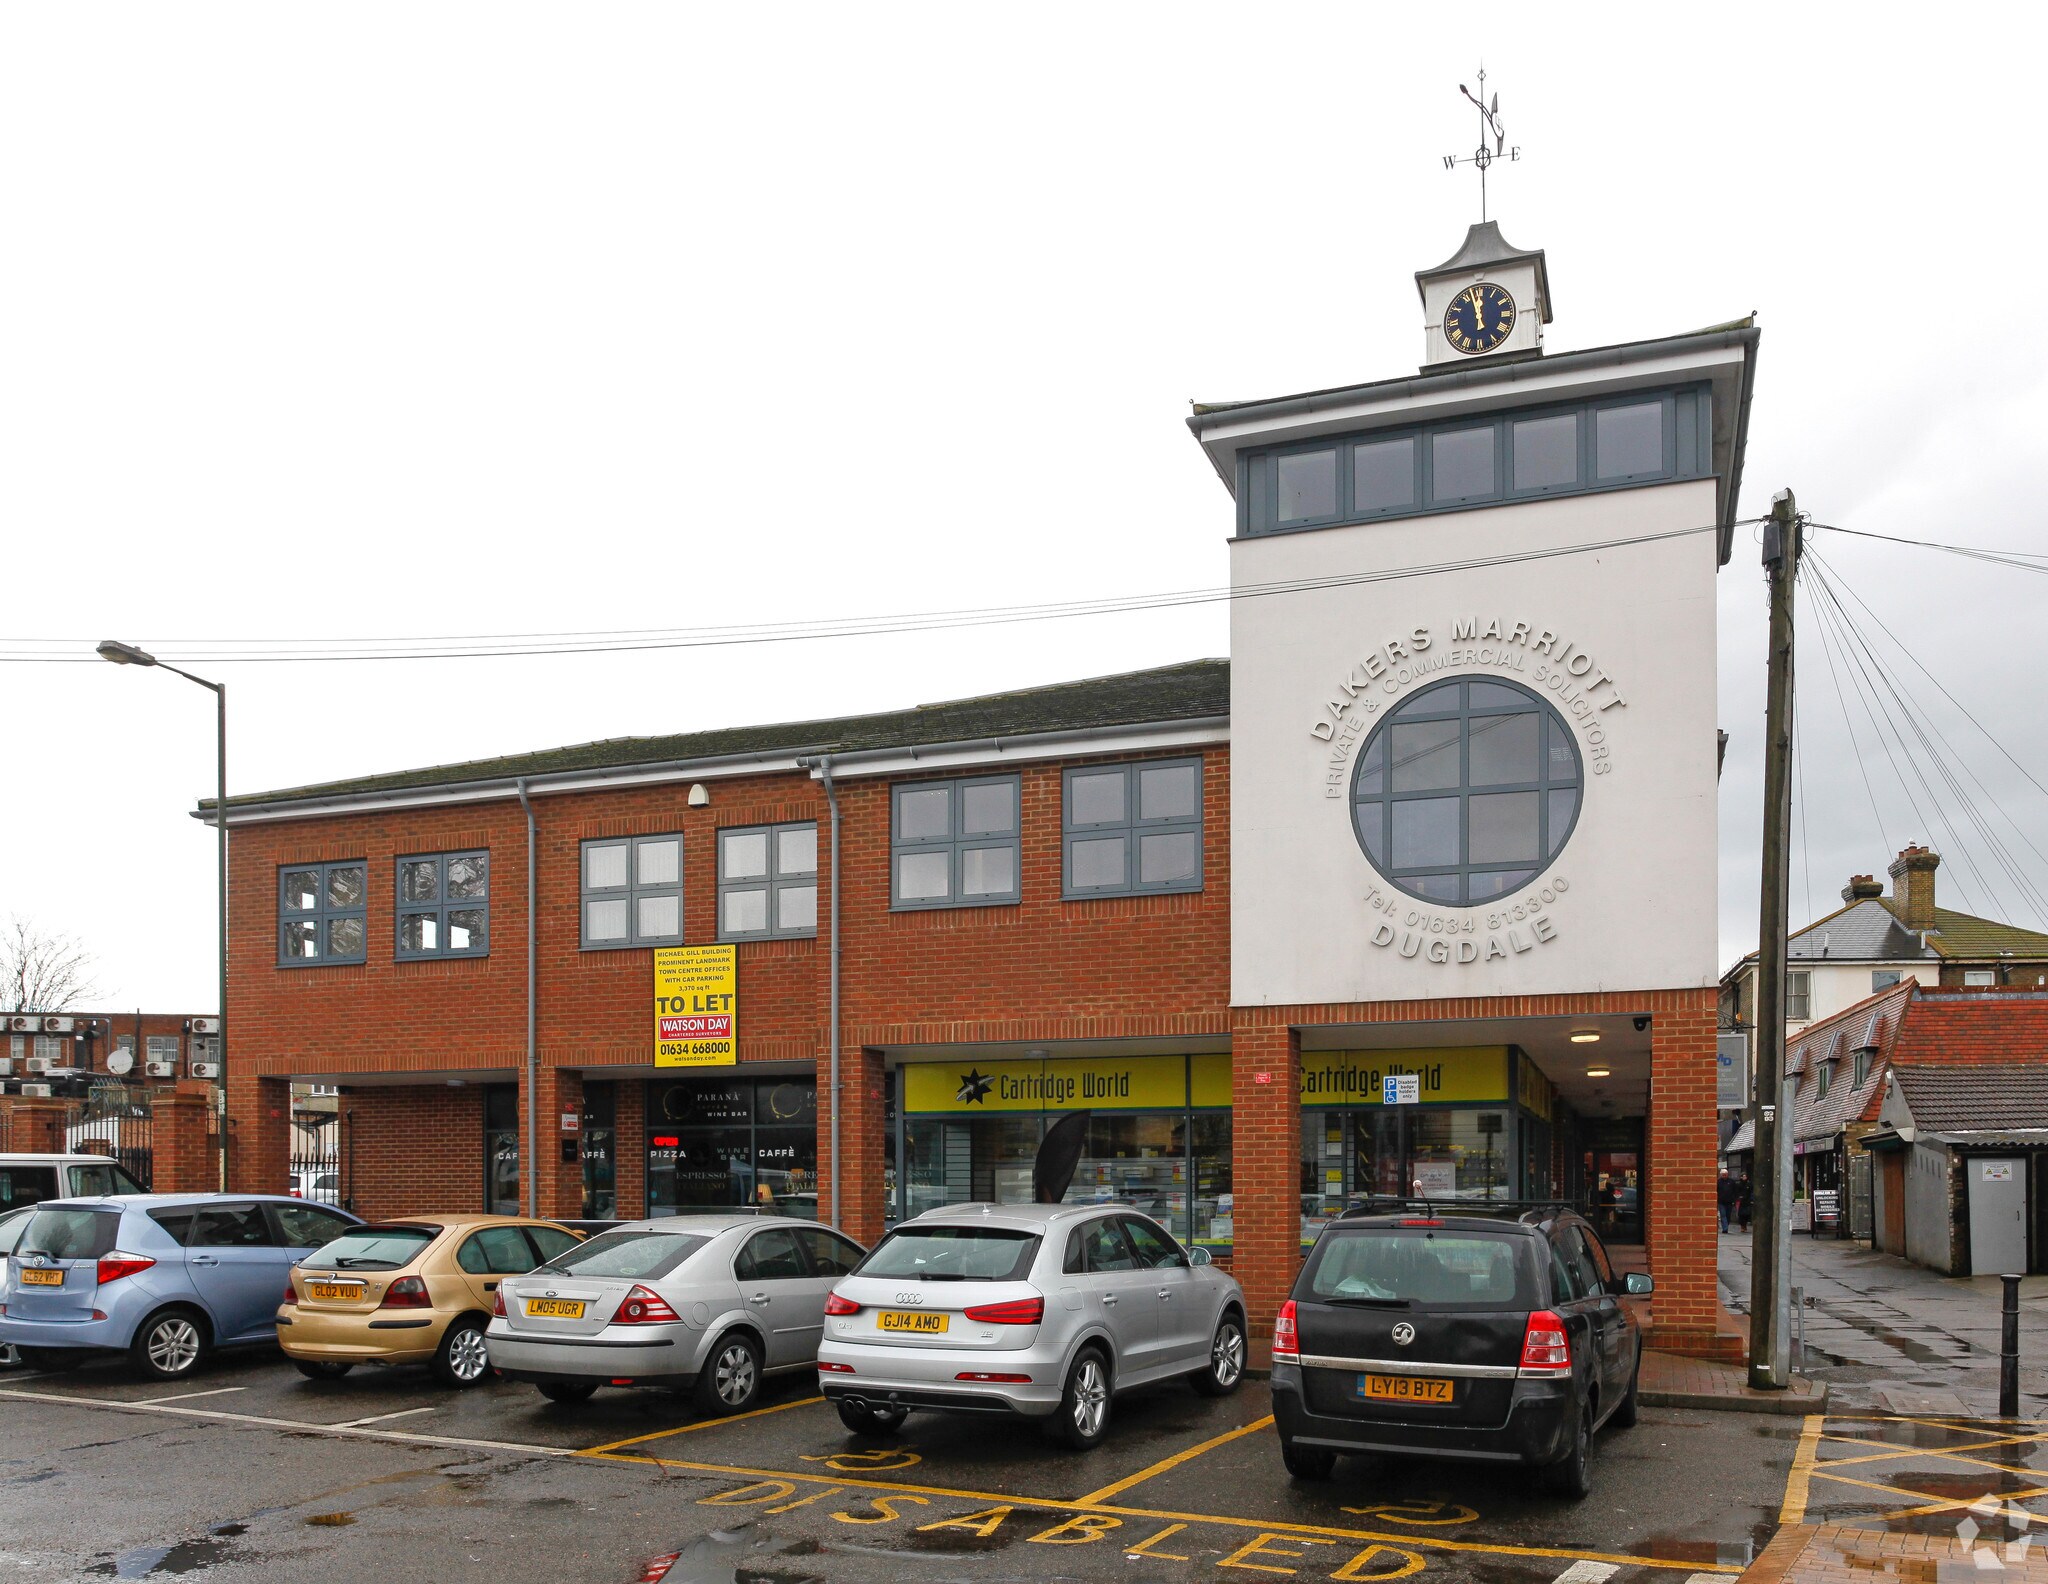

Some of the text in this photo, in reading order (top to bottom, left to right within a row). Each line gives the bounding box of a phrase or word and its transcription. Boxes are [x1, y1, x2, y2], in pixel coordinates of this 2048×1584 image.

[1511, 146, 1520, 161] E
[1443, 155, 1456, 170] W
[1310, 615, 1627, 743] DAKERS MARRIOTT
[1325, 648, 1611, 799] PRIVATE & COMMERCIAL SOLICITORS
[1364, 875, 1570, 934] Tel: 01634 813300
[1370, 915, 1557, 963] DUGDALE
[657, 994, 733, 1014] TO LET
[662, 1018, 728, 1032] WATSON DAY
[660, 1042, 730, 1055] 01634 668000
[1000, 1071, 1129, 1103] Cartridge World
[650, 1150, 687, 1158] PIZZA
[758, 1146, 795, 1157] CAFFÈ
[676, 1171, 727, 1180] ESPRESSO
[315, 1285, 358, 1298] GL02 VUU
[529, 1300, 579, 1315] LM05 UGR
[883, 1313, 941, 1330] GJ14 AMO
[1371, 1378, 1447, 1398] LY13 BTZ
[697, 1479, 1427, 1581] DISABLED
